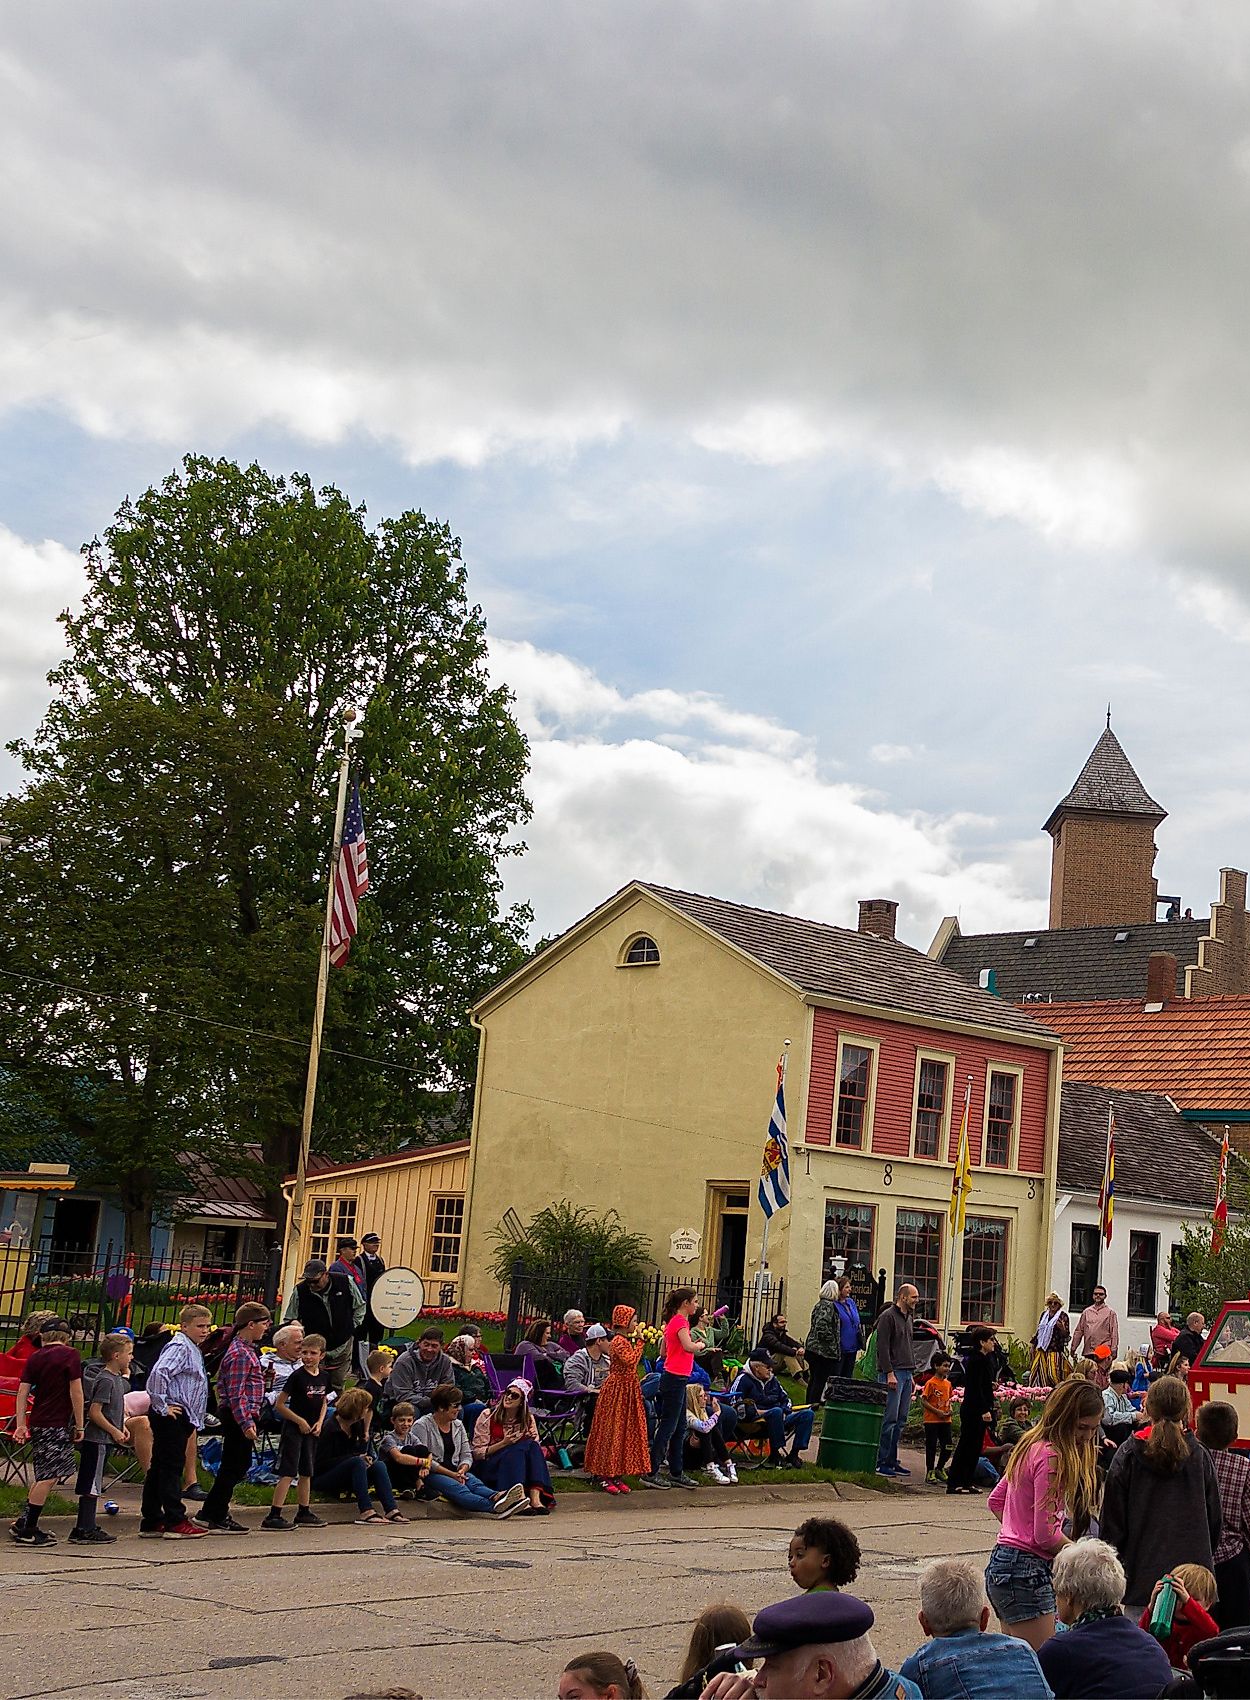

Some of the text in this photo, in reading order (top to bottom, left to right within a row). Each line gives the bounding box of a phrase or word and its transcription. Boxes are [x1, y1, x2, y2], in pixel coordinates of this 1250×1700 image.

[805, 1152, 1036, 1200] 1 8 3
[850, 1270, 866, 1281] Pella
